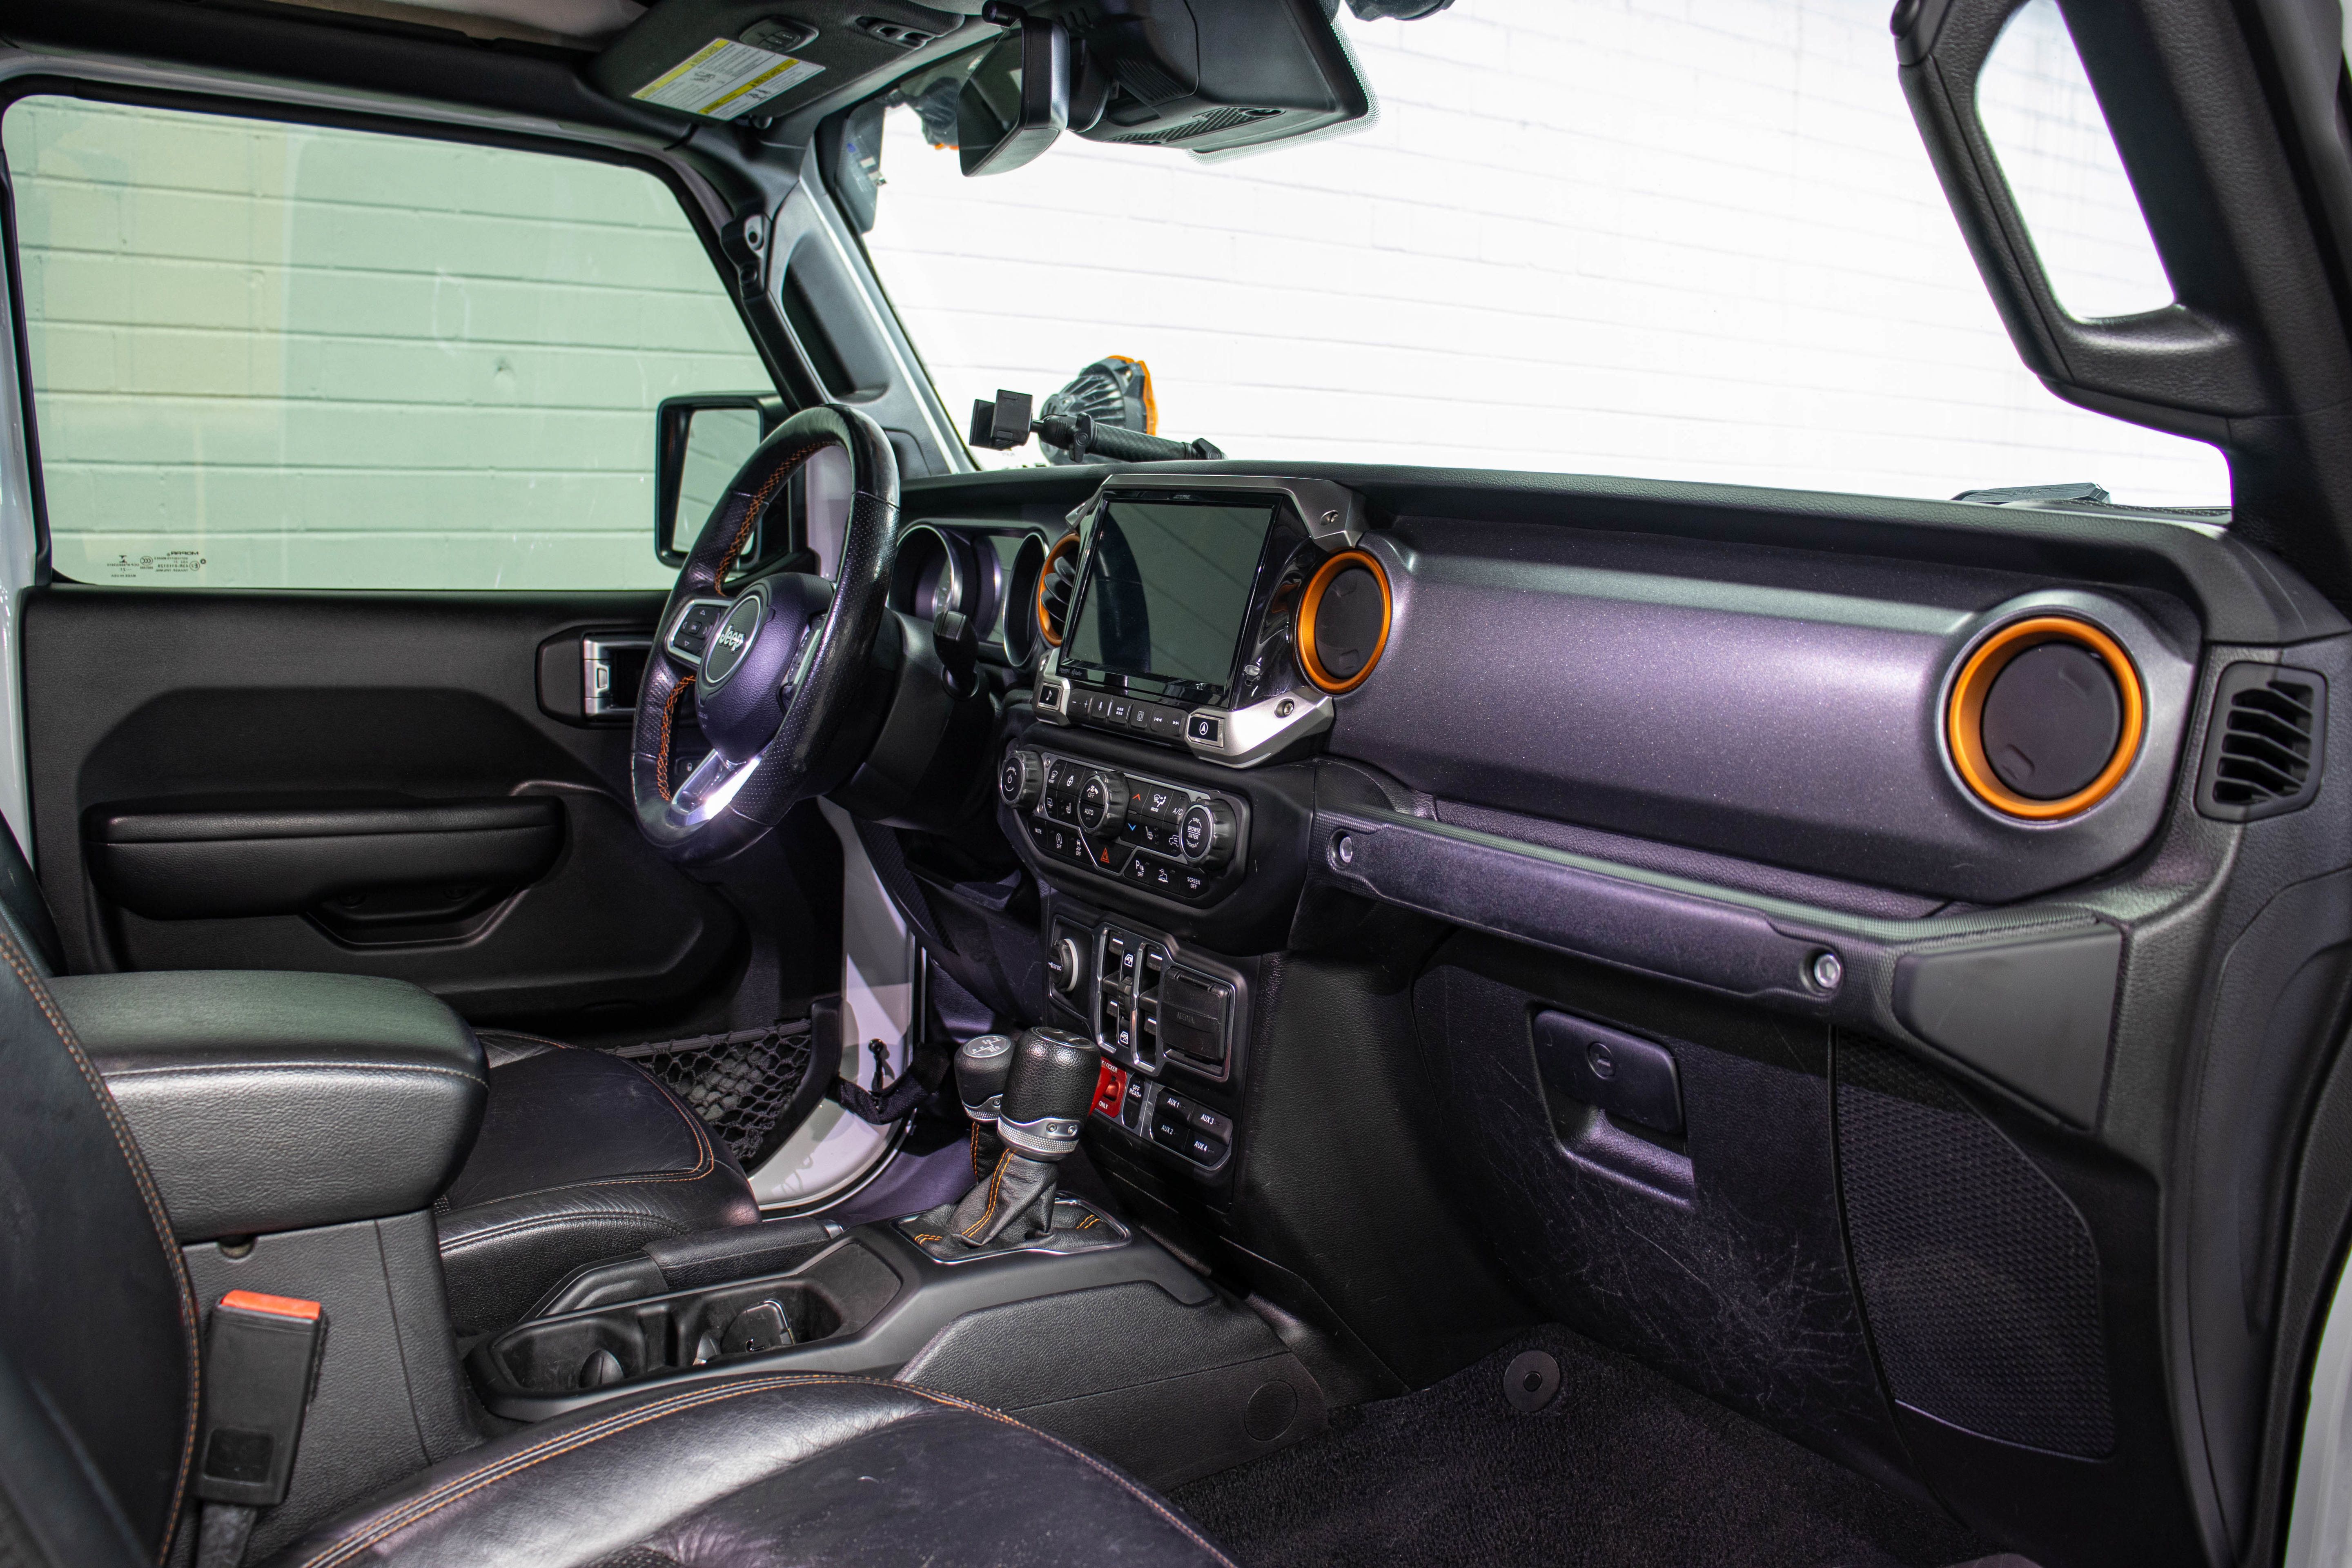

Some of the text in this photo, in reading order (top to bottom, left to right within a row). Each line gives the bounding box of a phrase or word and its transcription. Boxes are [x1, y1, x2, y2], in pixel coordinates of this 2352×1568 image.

[719, 625, 744, 651] Jeep
[1187, 877, 1200, 885] SCREEN
[1104, 1062, 1118, 1073] LOCKER
[1099, 1100, 1108, 1109] ONLY
[1167, 1098, 1177, 1107] AUX
[1200, 1114, 1211, 1123] AUX
[1161, 1124, 1170, 1134] AUX
[1194, 1140, 1204, 1150] AUX
